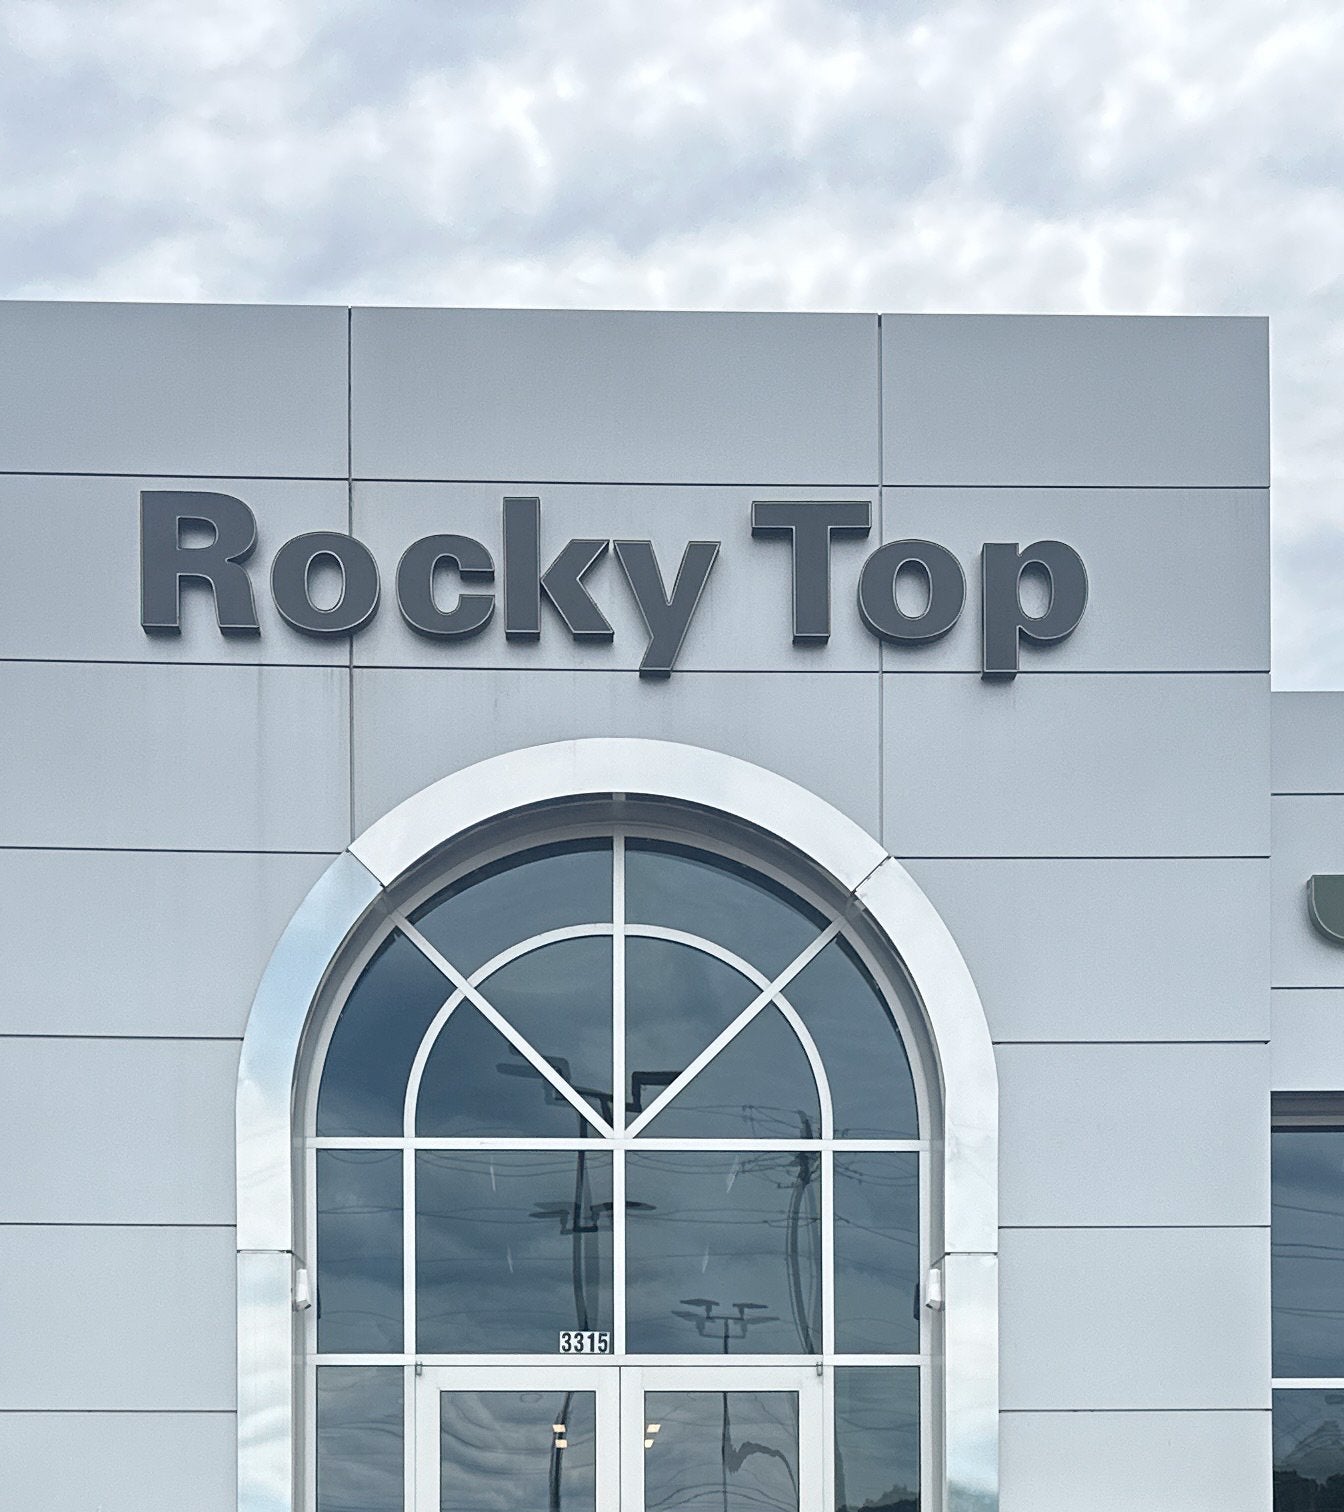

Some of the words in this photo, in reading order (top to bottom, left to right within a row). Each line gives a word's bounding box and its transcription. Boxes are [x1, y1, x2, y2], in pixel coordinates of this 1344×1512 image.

[140, 490, 721, 679] Rocky
[751, 500, 1089, 679] Top
[561, 1332, 608, 1353] 3315
